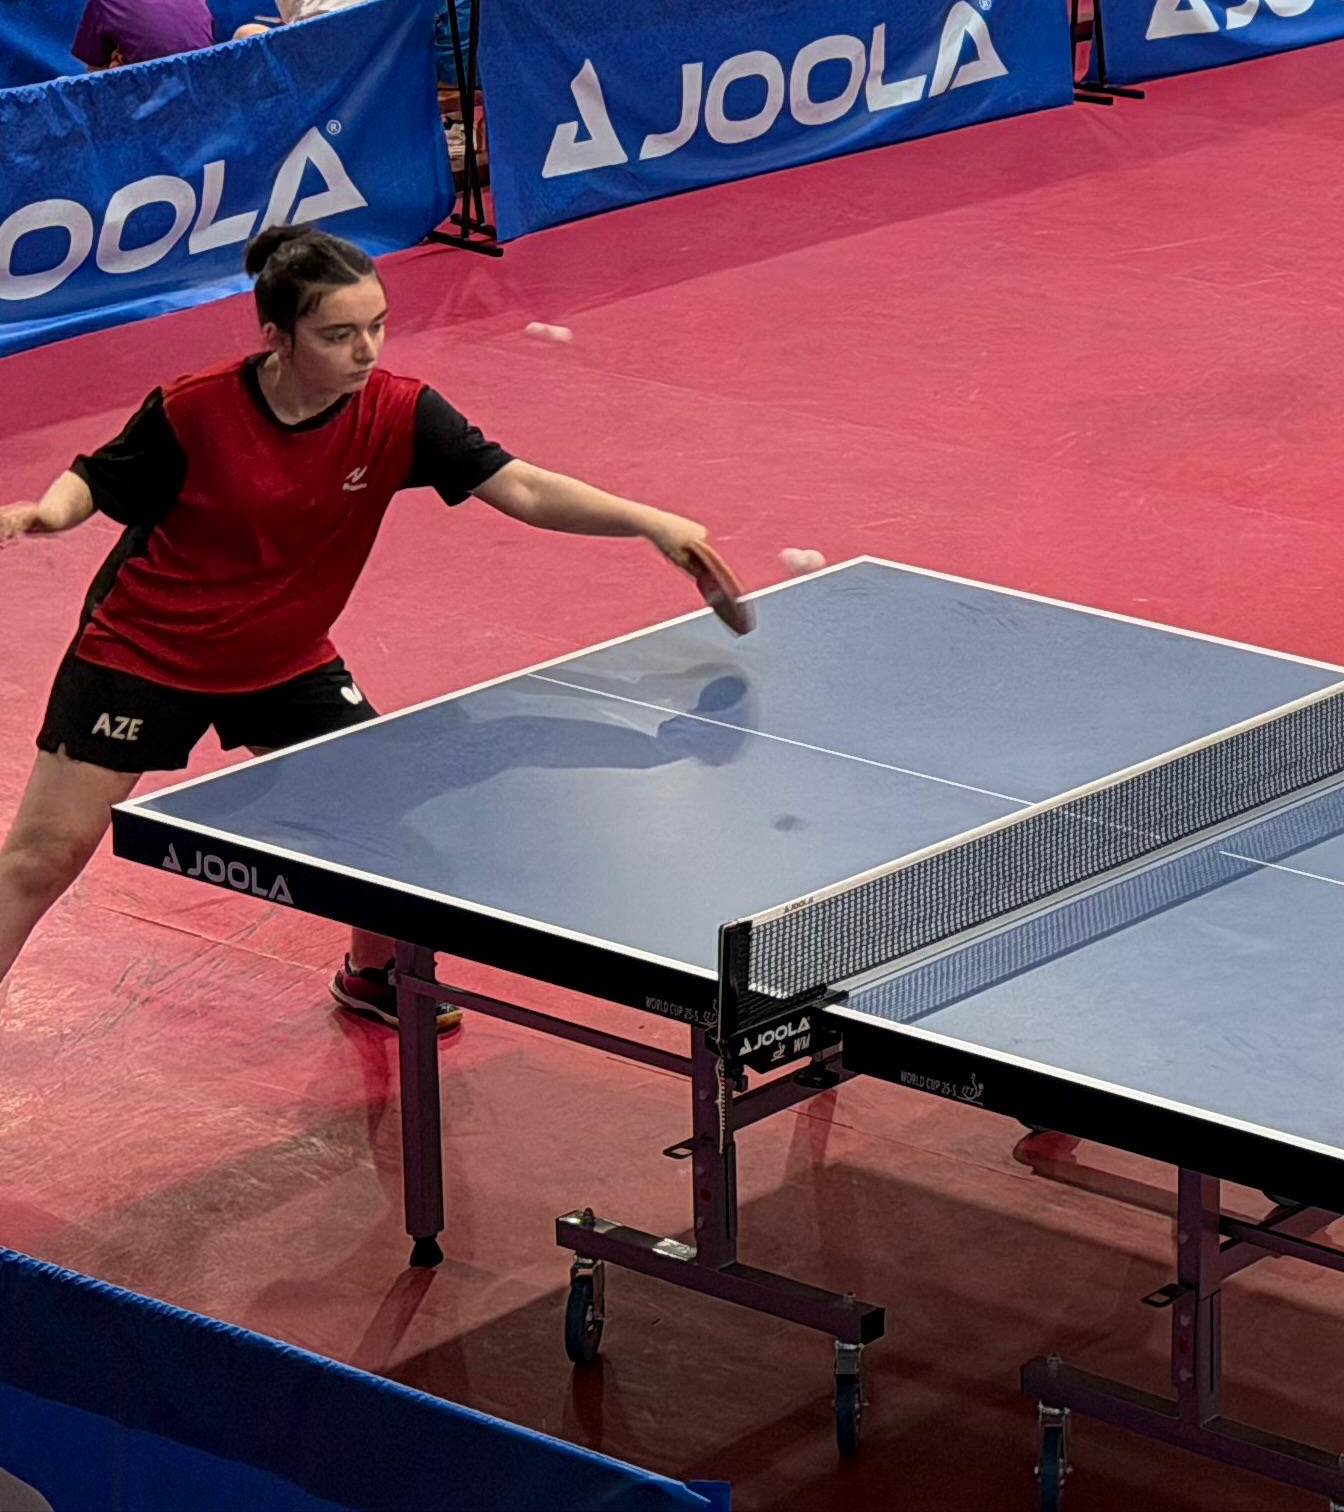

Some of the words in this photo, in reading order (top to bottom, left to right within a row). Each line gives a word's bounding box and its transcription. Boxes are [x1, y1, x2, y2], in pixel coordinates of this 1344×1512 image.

[638, 0, 1009, 161] JOOLA
[91, 712, 144, 741] AZE
[187, 849, 295, 905] JOOLA
[750, 1016, 811, 1052] JOOLA
